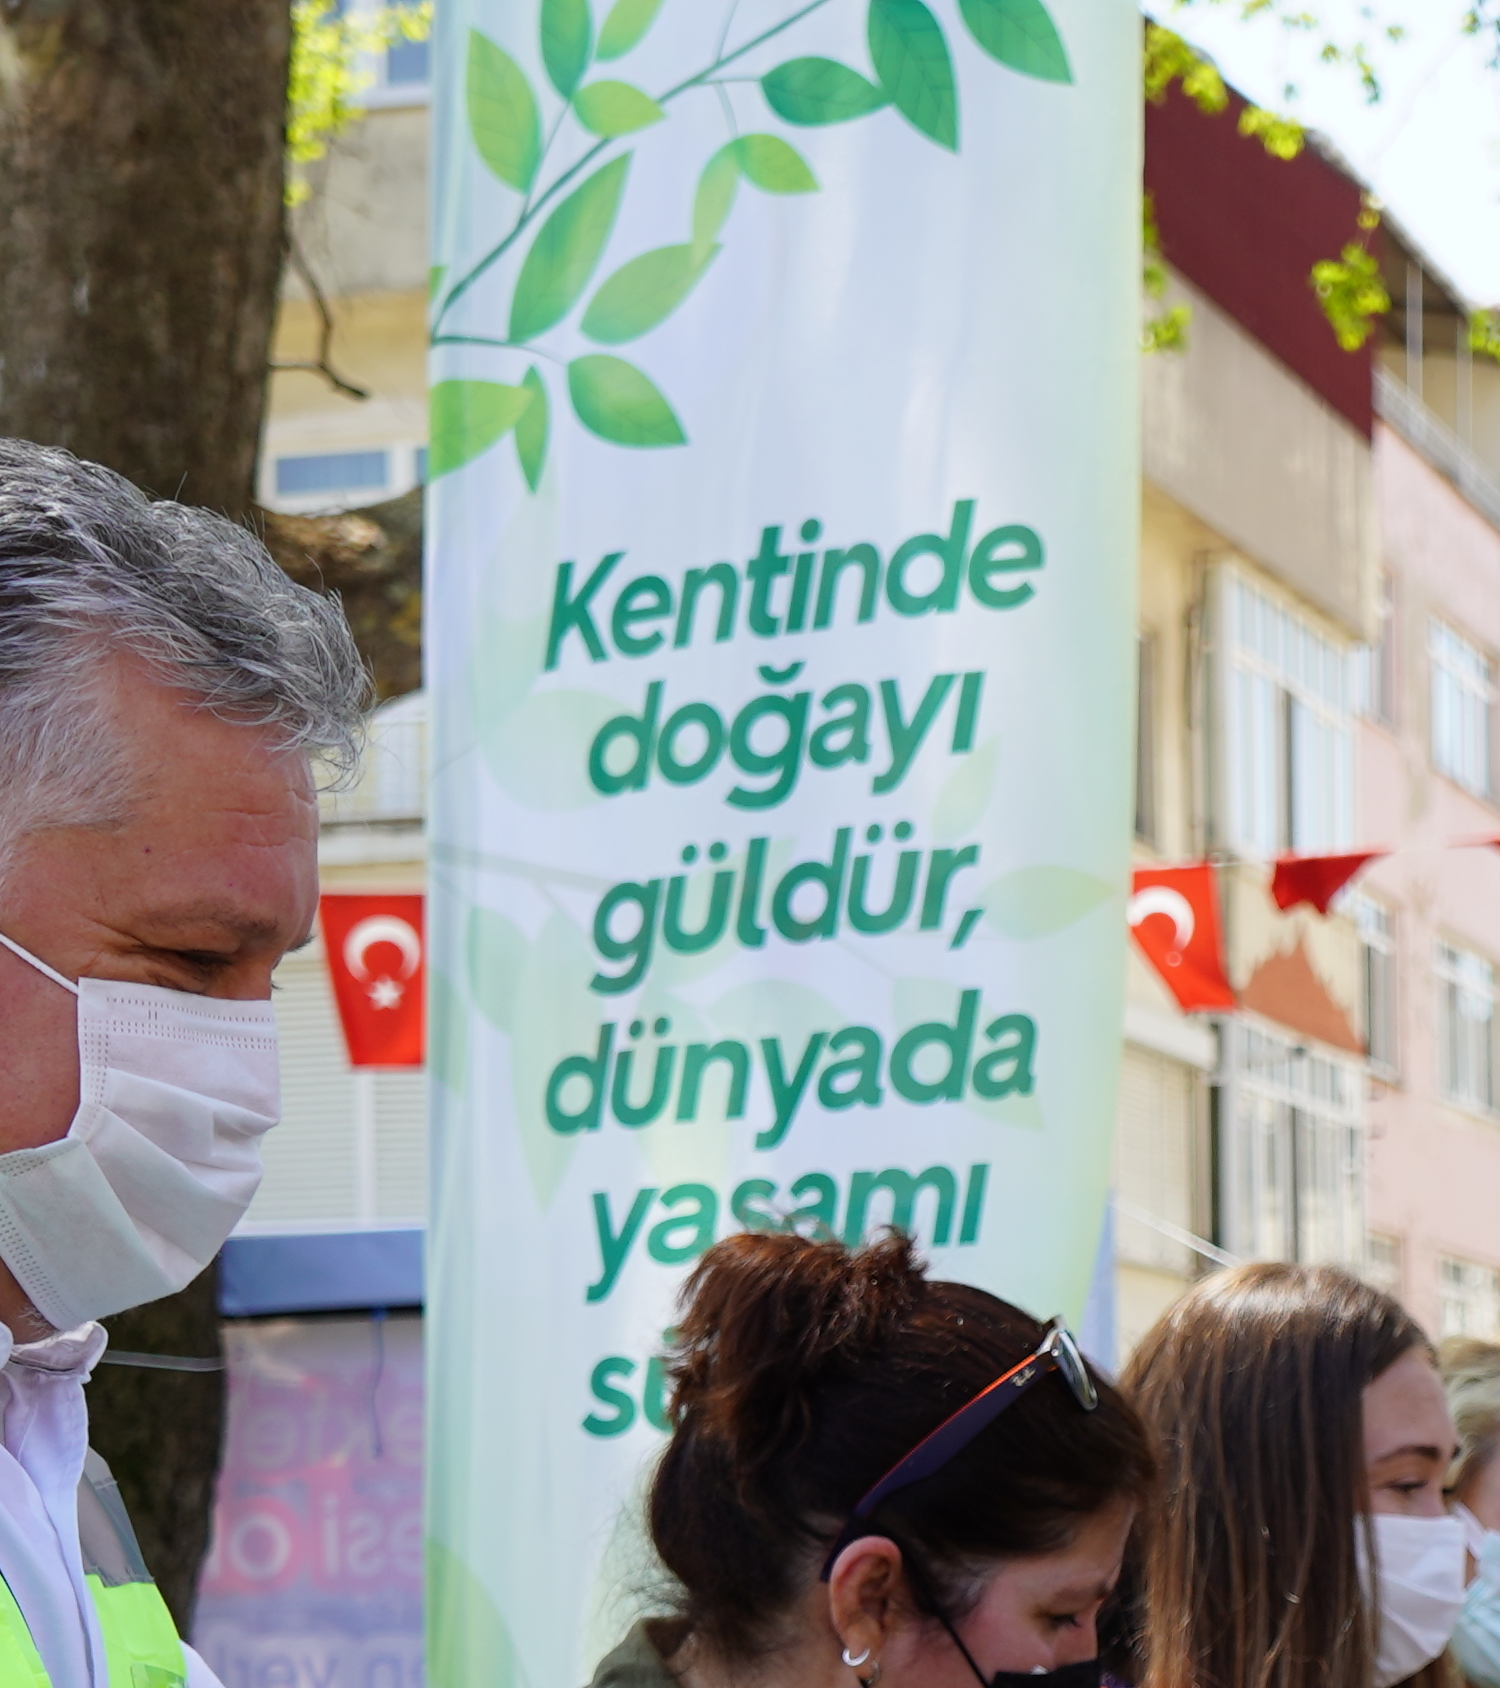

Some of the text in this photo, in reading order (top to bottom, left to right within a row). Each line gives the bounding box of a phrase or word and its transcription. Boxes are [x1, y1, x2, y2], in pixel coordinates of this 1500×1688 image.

[543, 497, 1046, 672] Kentinde
[587, 660, 985, 812] doğayı
[590, 819, 985, 996] güldür,
[544, 988, 1039, 1151] dünyada
